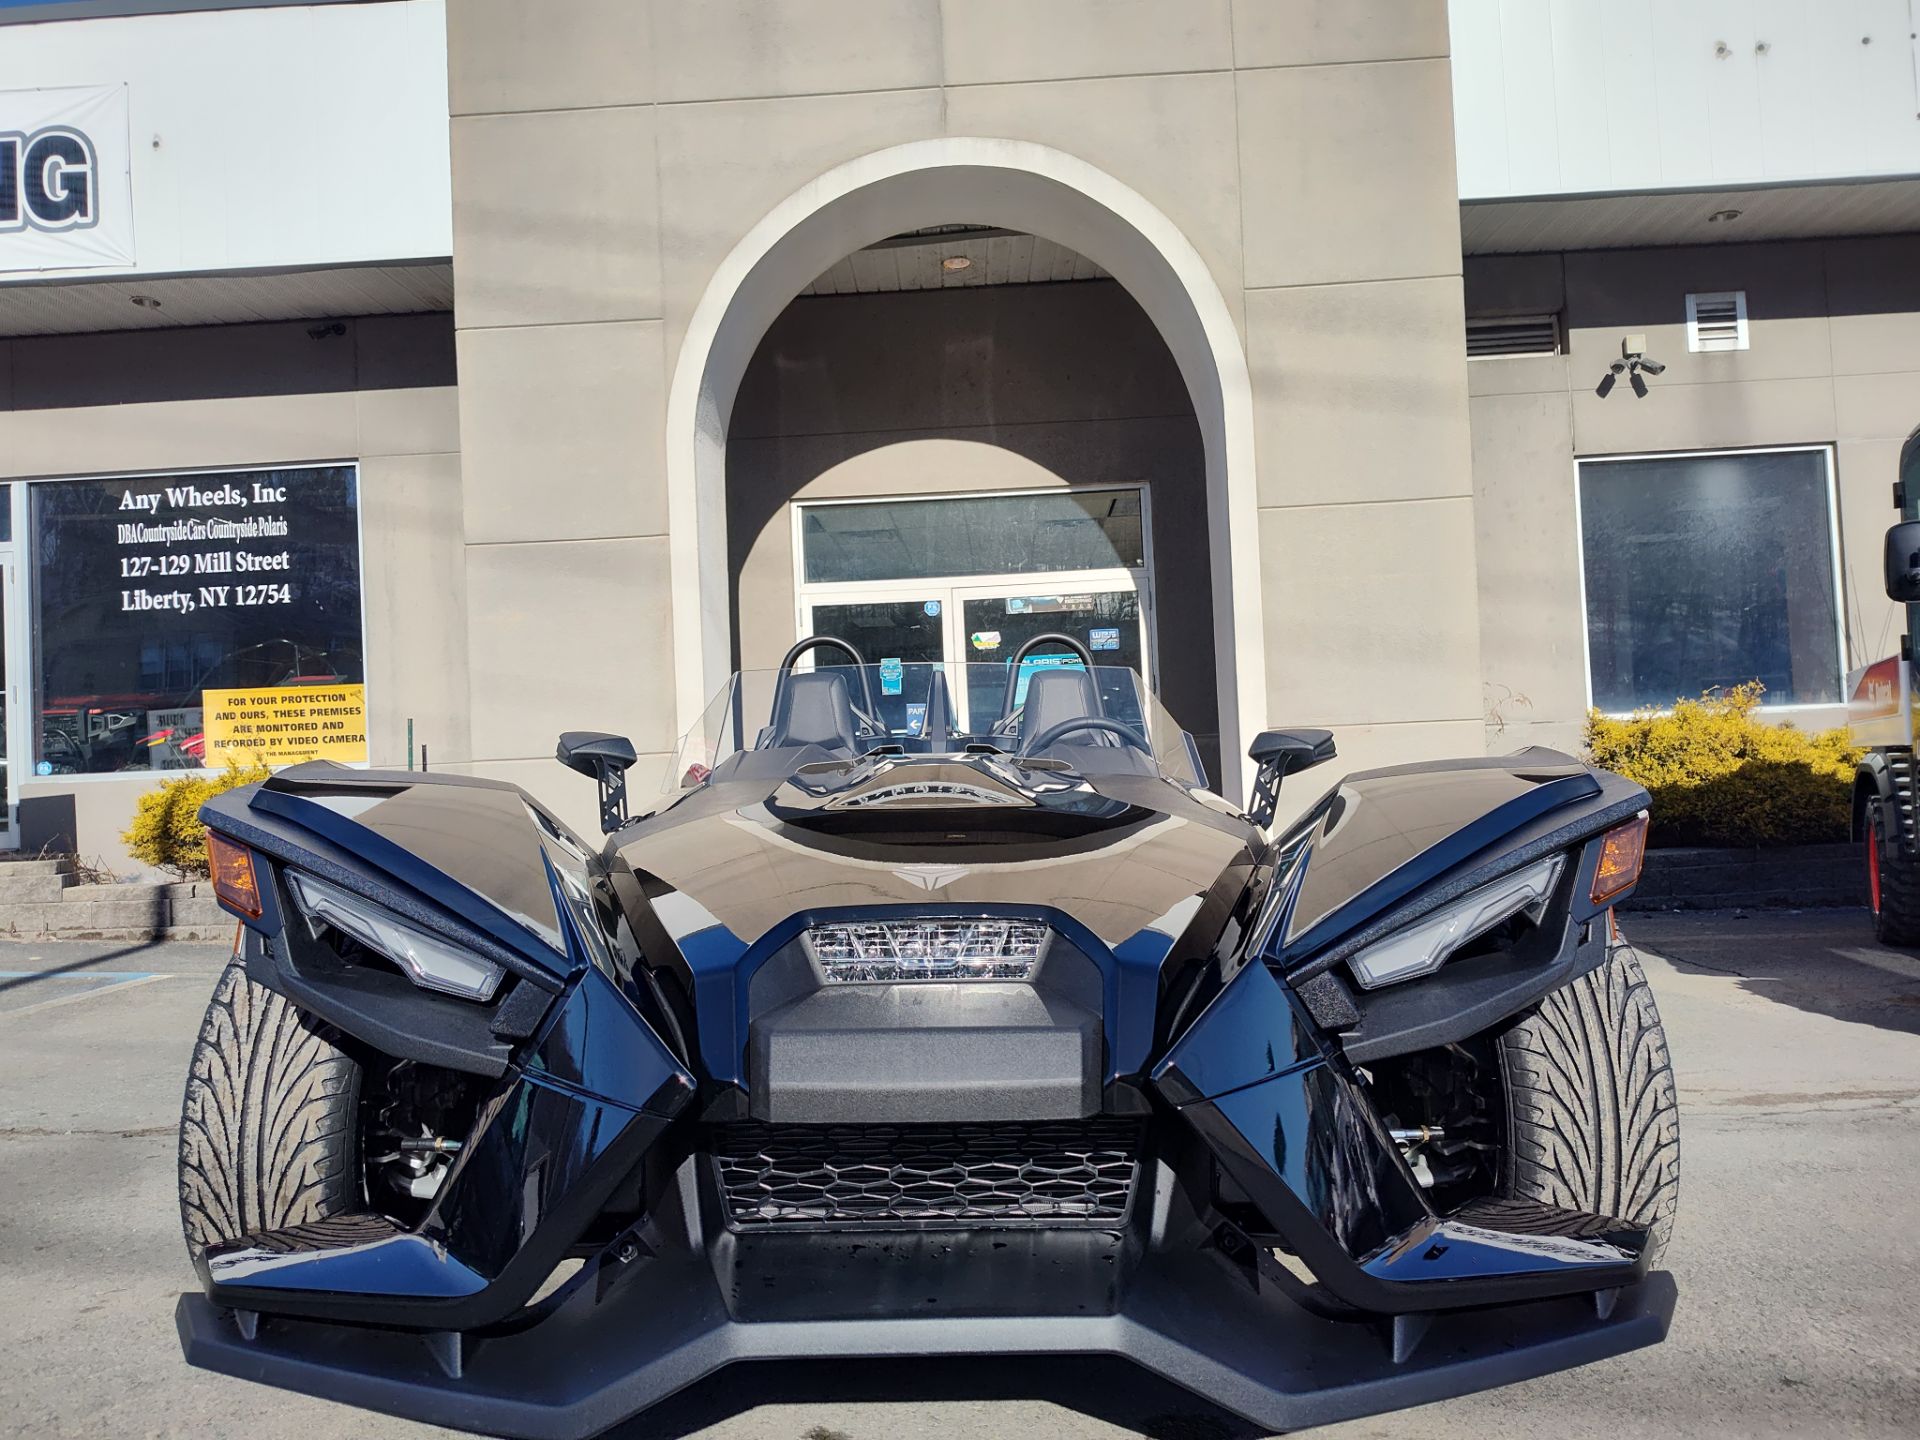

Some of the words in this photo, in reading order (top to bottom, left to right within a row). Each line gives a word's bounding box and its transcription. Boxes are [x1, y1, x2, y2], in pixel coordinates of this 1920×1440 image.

[118, 489, 161, 515] Any
[165, 484, 247, 507] Wheels,
[252, 483, 287, 503] Inc
[117, 524, 138, 545] DBA
[137, 519, 187, 547] Countryside
[187, 520, 206, 541] Cars
[207, 516, 258, 544] Countryside
[258, 515, 288, 537] Polaris
[121, 555, 190, 577] 127-129
[194, 551, 232, 574] Mill
[236, 551, 290, 572] Street
[121, 589, 195, 614] Liberty,
[199, 586, 230, 608] NY
[235, 583, 291, 606] 12754
[228, 697, 247, 706] FOR
[250, 695, 278, 705] YOUR
[281, 693, 347, 704] PROTECTION
[215, 712, 237, 721] AND
[240, 710, 269, 720] OURS,
[273, 708, 306, 718] THESE
[310, 706, 361, 716] PREMISES
[233, 724, 252, 734] ARE
[256, 722, 318, 733] MONITORED
[322, 721, 344, 730] AND
[214, 739, 266, 748] RECORDED
[270, 737, 283, 746] BY
[287, 736, 319, 745] VIDEO
[322, 734, 366, 744] CAMERA
